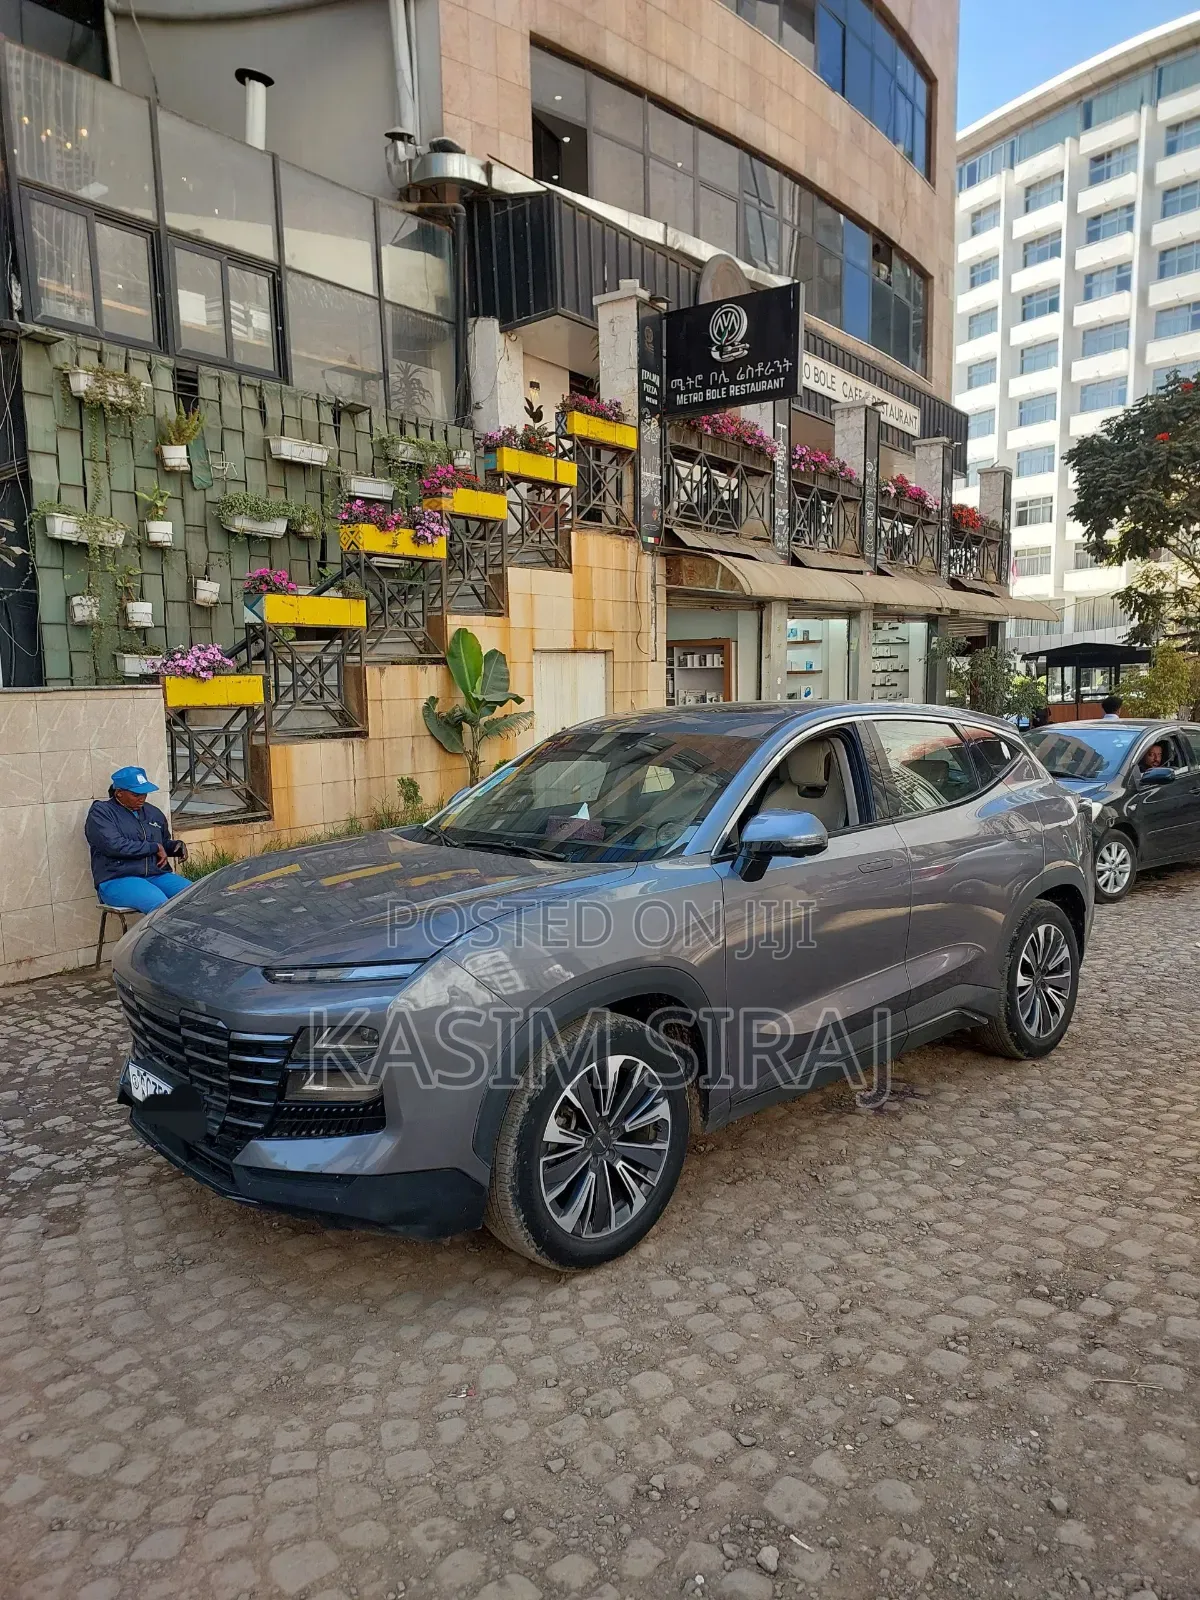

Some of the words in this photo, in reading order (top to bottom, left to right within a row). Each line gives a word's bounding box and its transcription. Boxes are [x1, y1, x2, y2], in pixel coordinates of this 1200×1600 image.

[709, 369, 730, 385] ቦሌ
[643, 382, 658, 396] PIZZA
[676, 391, 704, 406] METRO
[705, 387, 727, 401] BOLE
[729, 377, 785, 397] RESTAURANT
[813, 366, 836, 392] BOLE
[871, 395, 918, 430] STAURANT
